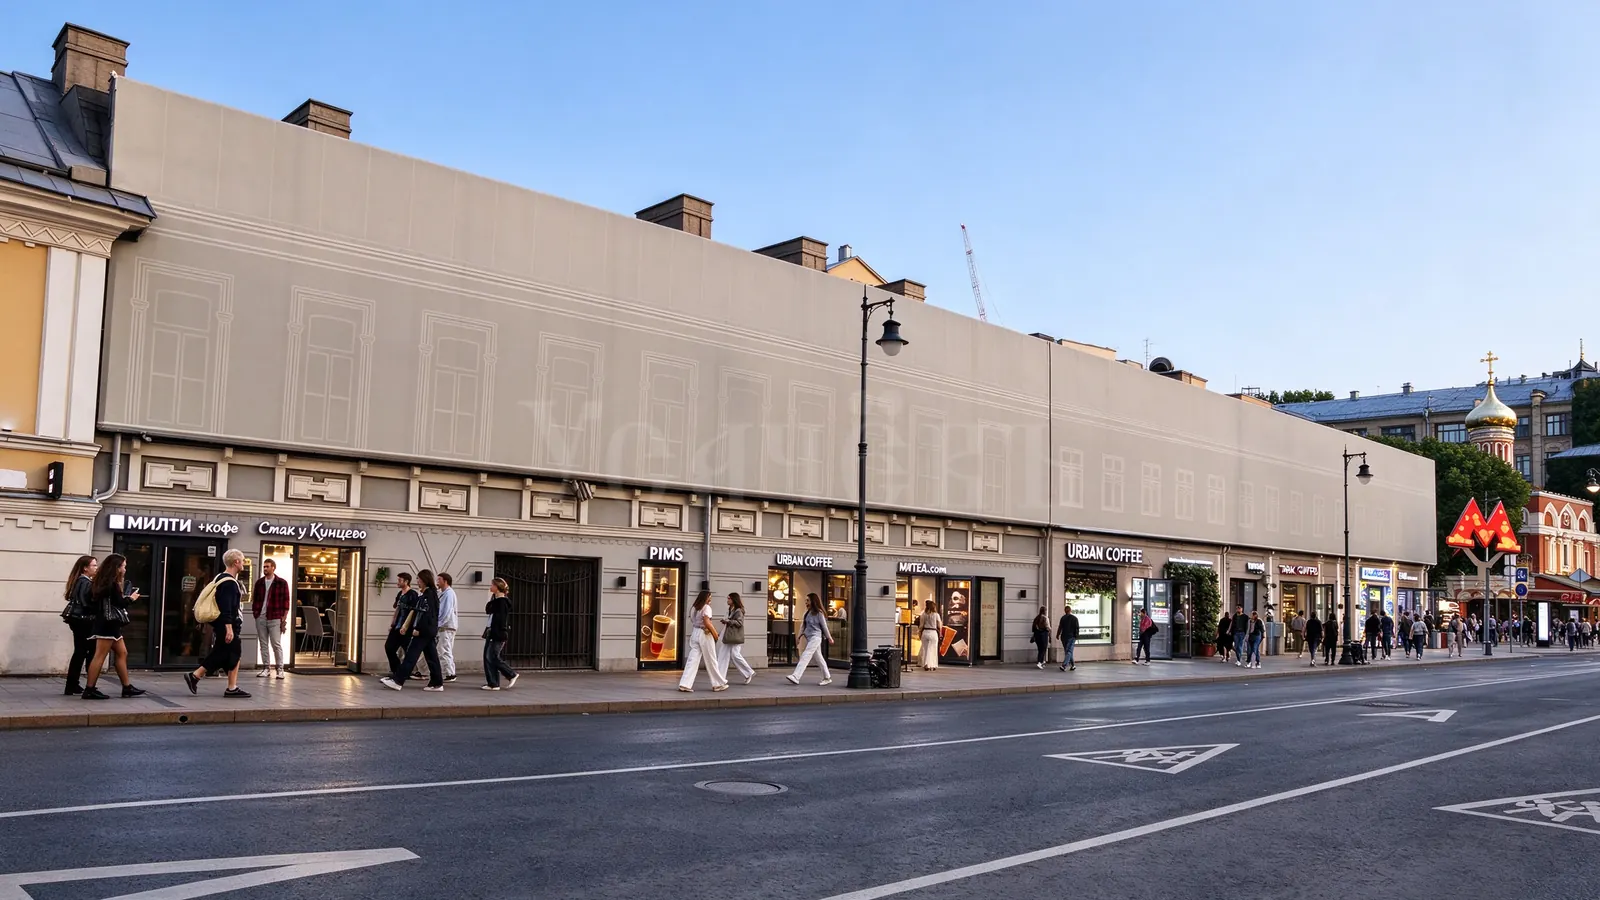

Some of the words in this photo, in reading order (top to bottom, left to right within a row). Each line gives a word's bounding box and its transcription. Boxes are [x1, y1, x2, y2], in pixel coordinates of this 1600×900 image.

[127, 515, 192, 533] МИЛТИ
[198, 521, 239, 536] +кофе
[258, 521, 295, 536] Стак
[297, 527, 307, 540] у
[310, 522, 367, 541] Кинцево
[650, 546, 684, 561] PIMS
[777, 553, 803, 566] URBAN
[805, 556, 833, 568] COFFEE
[1067, 542, 1104, 561] URBAN
[1106, 547, 1143, 563] COFFEE
